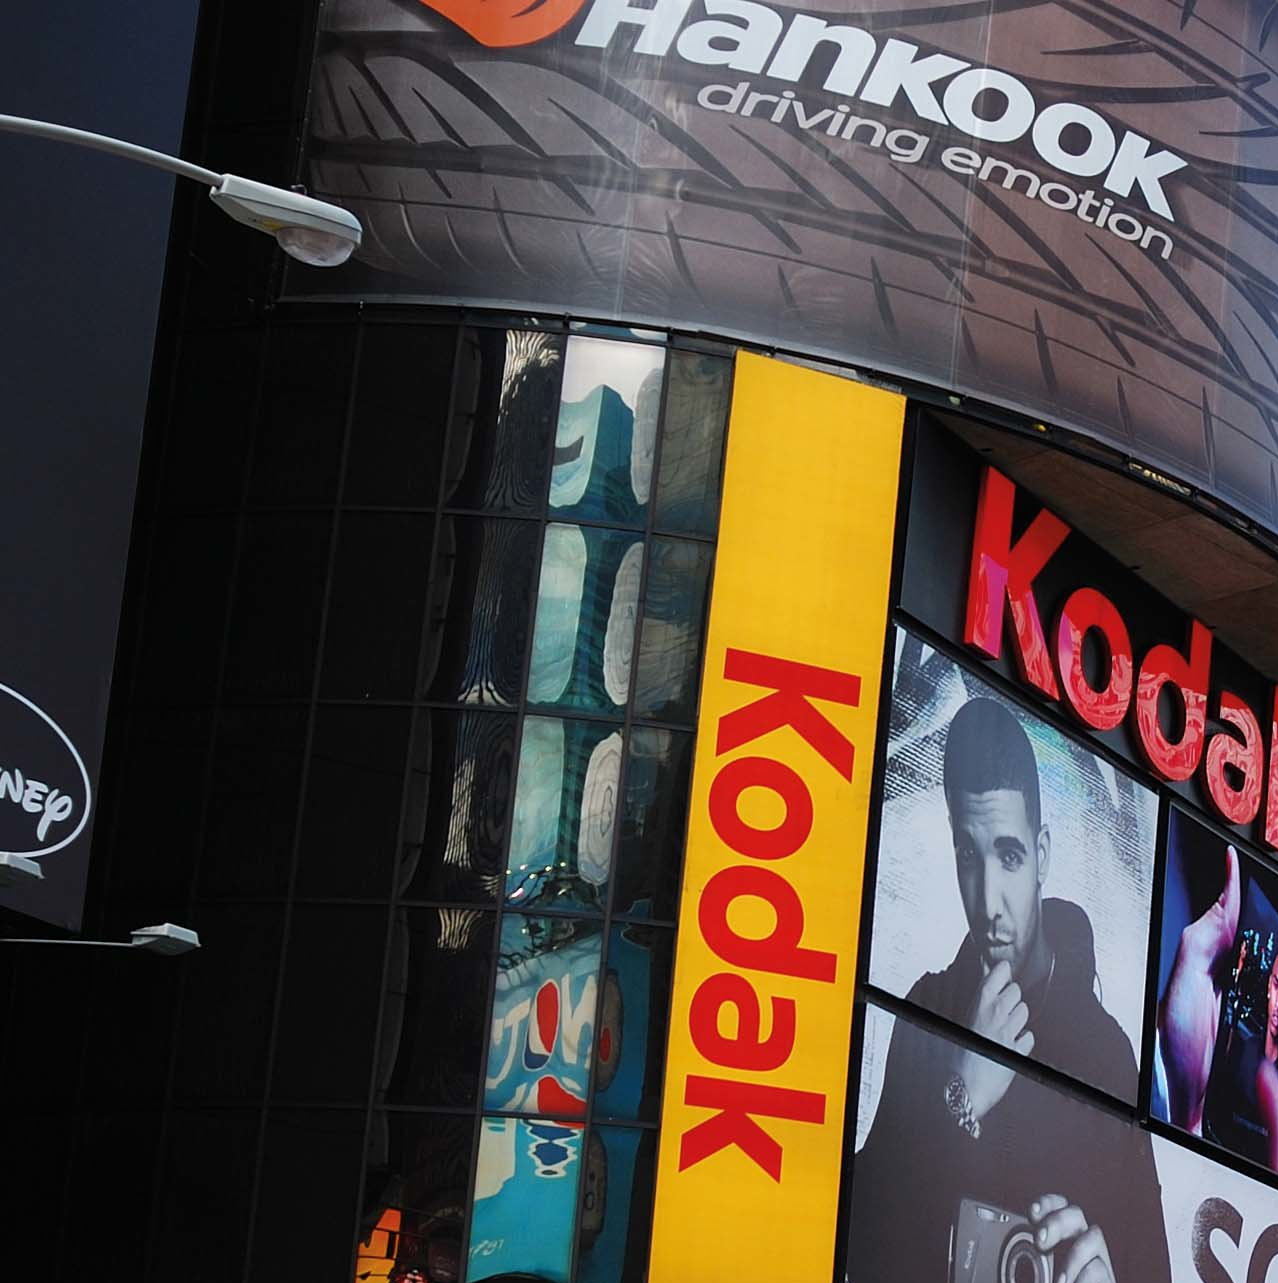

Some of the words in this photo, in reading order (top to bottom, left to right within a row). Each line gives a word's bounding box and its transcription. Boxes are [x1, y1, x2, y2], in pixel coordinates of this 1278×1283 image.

[698, 81, 928, 163] driving
[941, 143, 1174, 260] emotion
[0, 767, 72, 841] NEY
[678, 648, 862, 1184] Kodak
